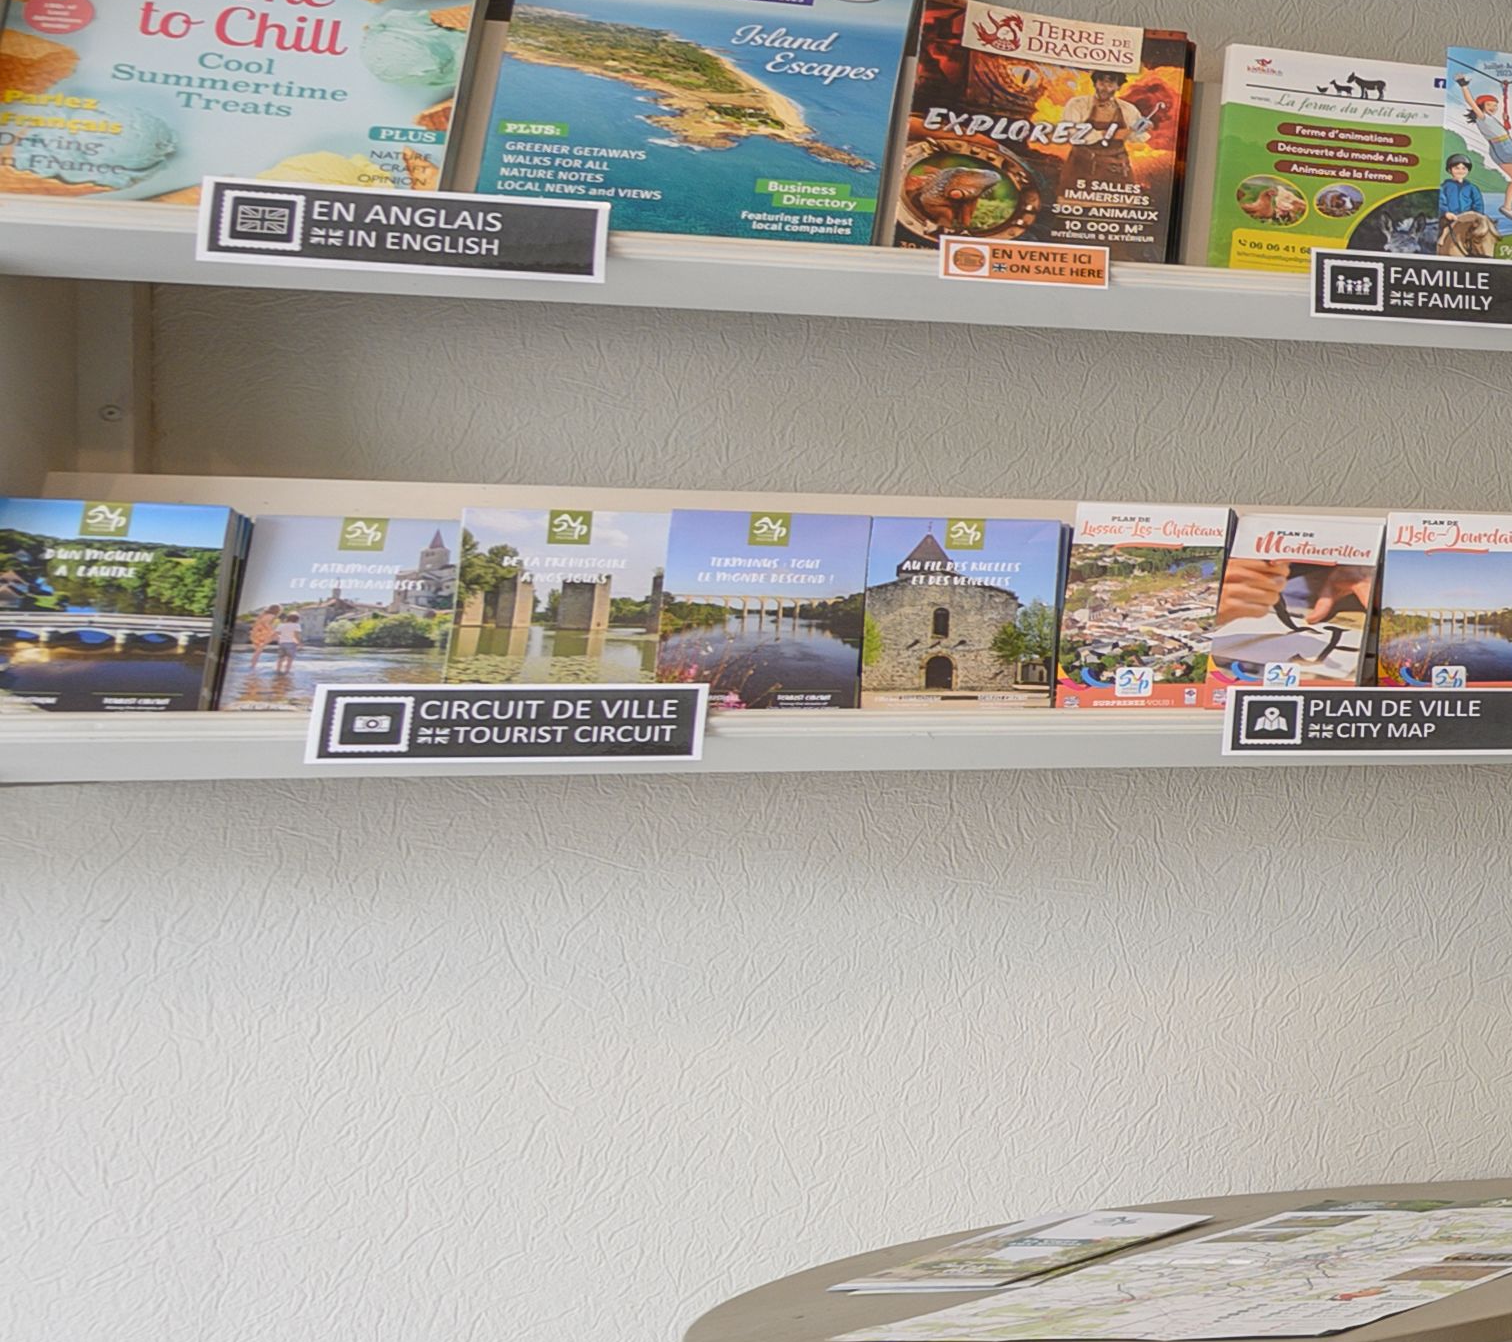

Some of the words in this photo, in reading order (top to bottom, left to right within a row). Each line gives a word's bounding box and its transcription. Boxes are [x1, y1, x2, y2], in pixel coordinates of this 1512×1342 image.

[139, 1, 204, 39] to
[214, 6, 348, 56] Chill
[731, 23, 839, 53] Island
[1033, 18, 1105, 47] TERRE
[1111, 37, 1132, 49] DE
[1027, 36, 1135, 66] DRAGONS
[197, 52, 275, 75] Cool
[765, 53, 880, 85] Escapes
[112, 63, 348, 102] Summertime
[4, 88, 100, 111] Parlez
[177, 90, 293, 118] Treats
[505, 123, 562, 136] PLUS:
[923, 106, 1094, 146] EXPLOREZ
[369, 149, 432, 162] NATURE
[505, 141, 570, 155] GREENER
[572, 145, 646, 160] GETAWAYS
[379, 162, 427, 175] CRAFT
[497, 180, 543, 193] LOCAL
[544, 184, 586, 196] NEWS
[588, 186, 615, 197] and
[617, 188, 662, 200] VIEWS
[768, 181, 836, 195] Business
[782, 194, 857, 211] Directory
[1051, 204, 1086, 216] 300
[1088, 206, 1158, 221] ANIMAUX
[311, 201, 355, 222] EN
[364, 205, 504, 232] ANGLAIS
[348, 229, 376, 248] IN
[384, 231, 500, 256] ENGLISH
[1389, 265, 1490, 292] FAMILLE
[1416, 290, 1493, 313] FAMILY
[1255, 531, 1372, 559] Montmorillon
[419, 700, 547, 720] CIRCUIT
[552, 700, 592, 720] DE
[600, 698, 680, 721] VILLE
[1310, 699, 1374, 719] PLAN
[1380, 699, 1414, 718] DE
[1418, 699, 1482, 719] VILLE
[453, 724, 566, 744] TOURIST
[573, 724, 677, 744] CIRCUIT
[1336, 723, 1382, 739] CITY
[1388, 723, 1436, 739] MAP
